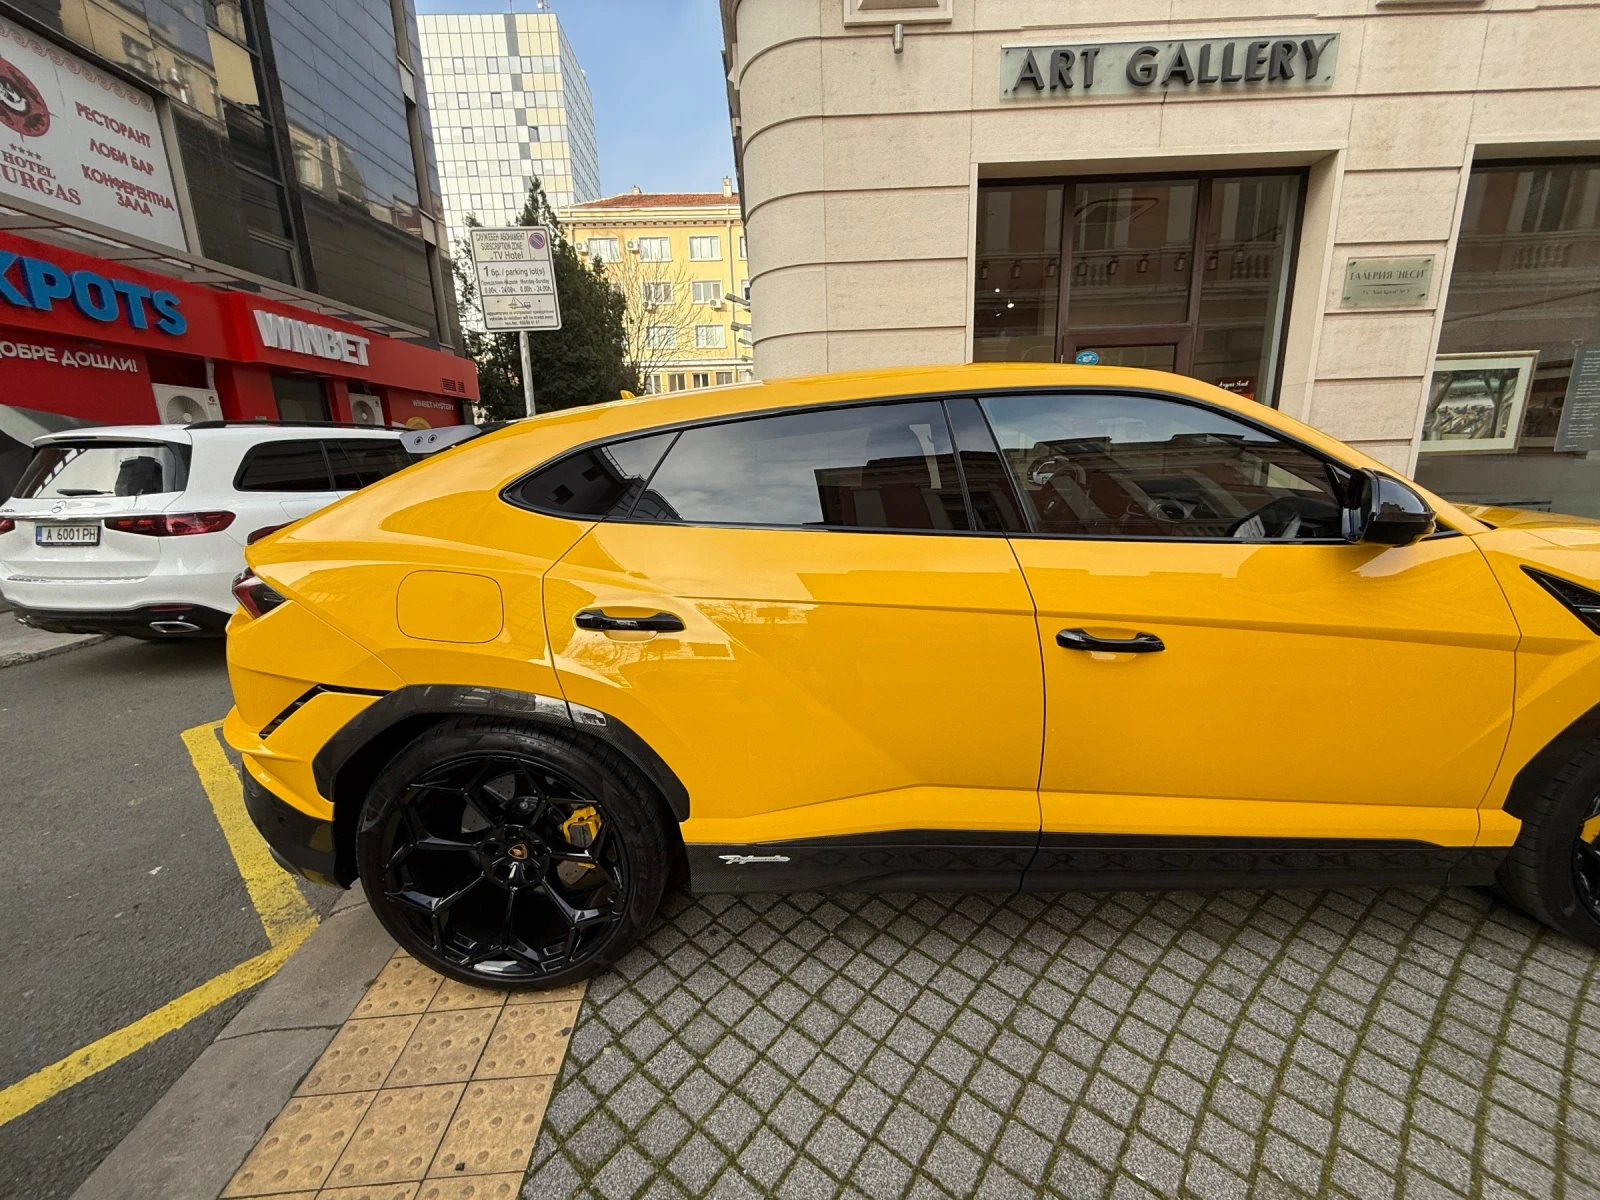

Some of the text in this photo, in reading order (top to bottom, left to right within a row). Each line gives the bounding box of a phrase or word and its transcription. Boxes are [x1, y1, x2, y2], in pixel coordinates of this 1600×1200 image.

[1012, 38, 1332, 91] ART GALLERY
[75, 101, 151, 148] РЕСТОРАНТ
[1, 150, 56, 180] HOTEL
[90, 138, 154, 176] ЛОБИ БАР
[0, 163, 81, 205] URGAS
[81, 164, 175, 211] КОНФЕРЕНТНА
[116, 192, 153, 217] ЗАЛА
[504, 250, 524, 259] Hotel
[511, 242, 523, 250] ZONE
[483, 265, 489, 276] 1
[506, 268, 528, 277] parking
[529, 267, 545, 276] lot(s)
[1350, 271, 1393, 280] ГАЛЕРИЯ
[253, 309, 370, 367] WINBET
[0, 340, 138, 372] ОБРЕ ДОШЛИ!
[412, 399, 433, 408] WINBET
[46, 528, 53, 540] A
